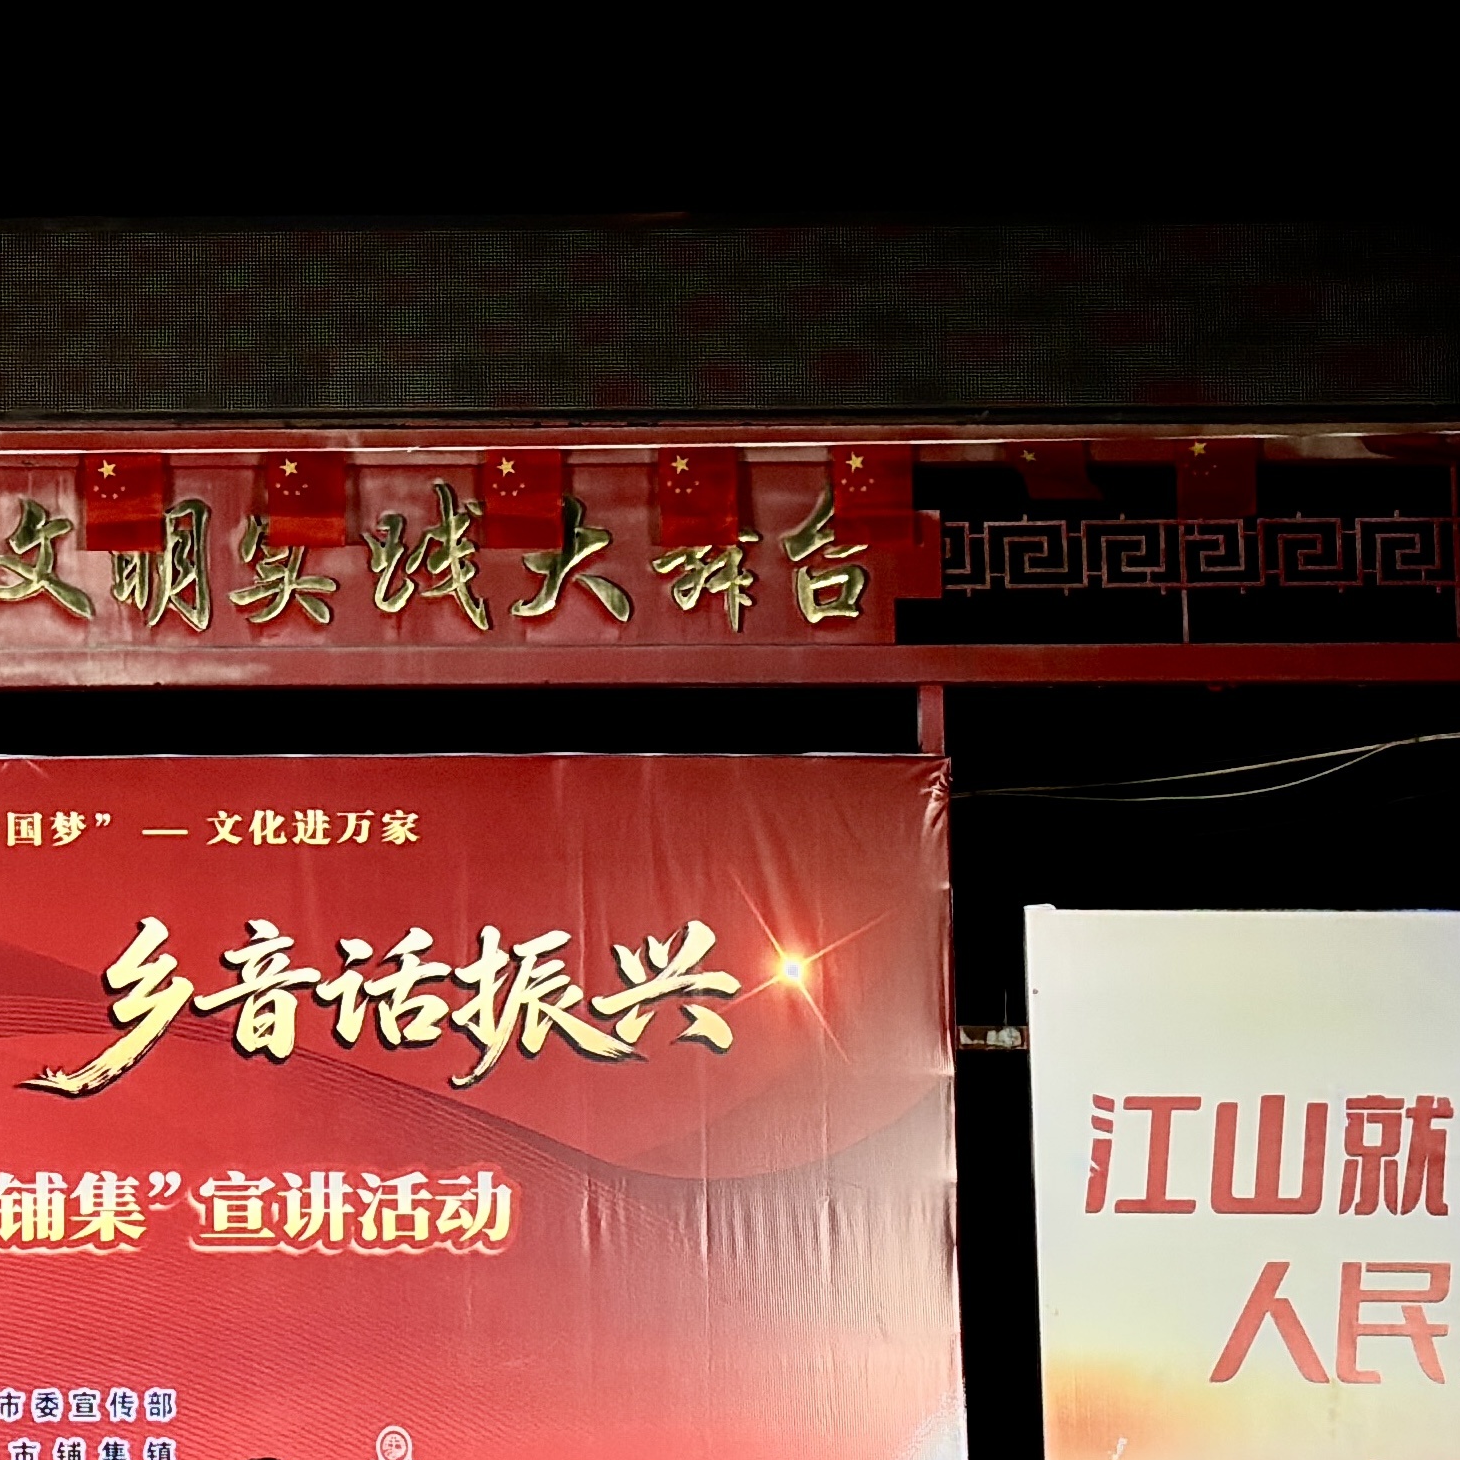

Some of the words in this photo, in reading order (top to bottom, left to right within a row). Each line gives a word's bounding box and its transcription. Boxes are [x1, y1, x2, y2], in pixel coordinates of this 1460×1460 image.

[20, 916, 742, 1095] 乡音话振兴
